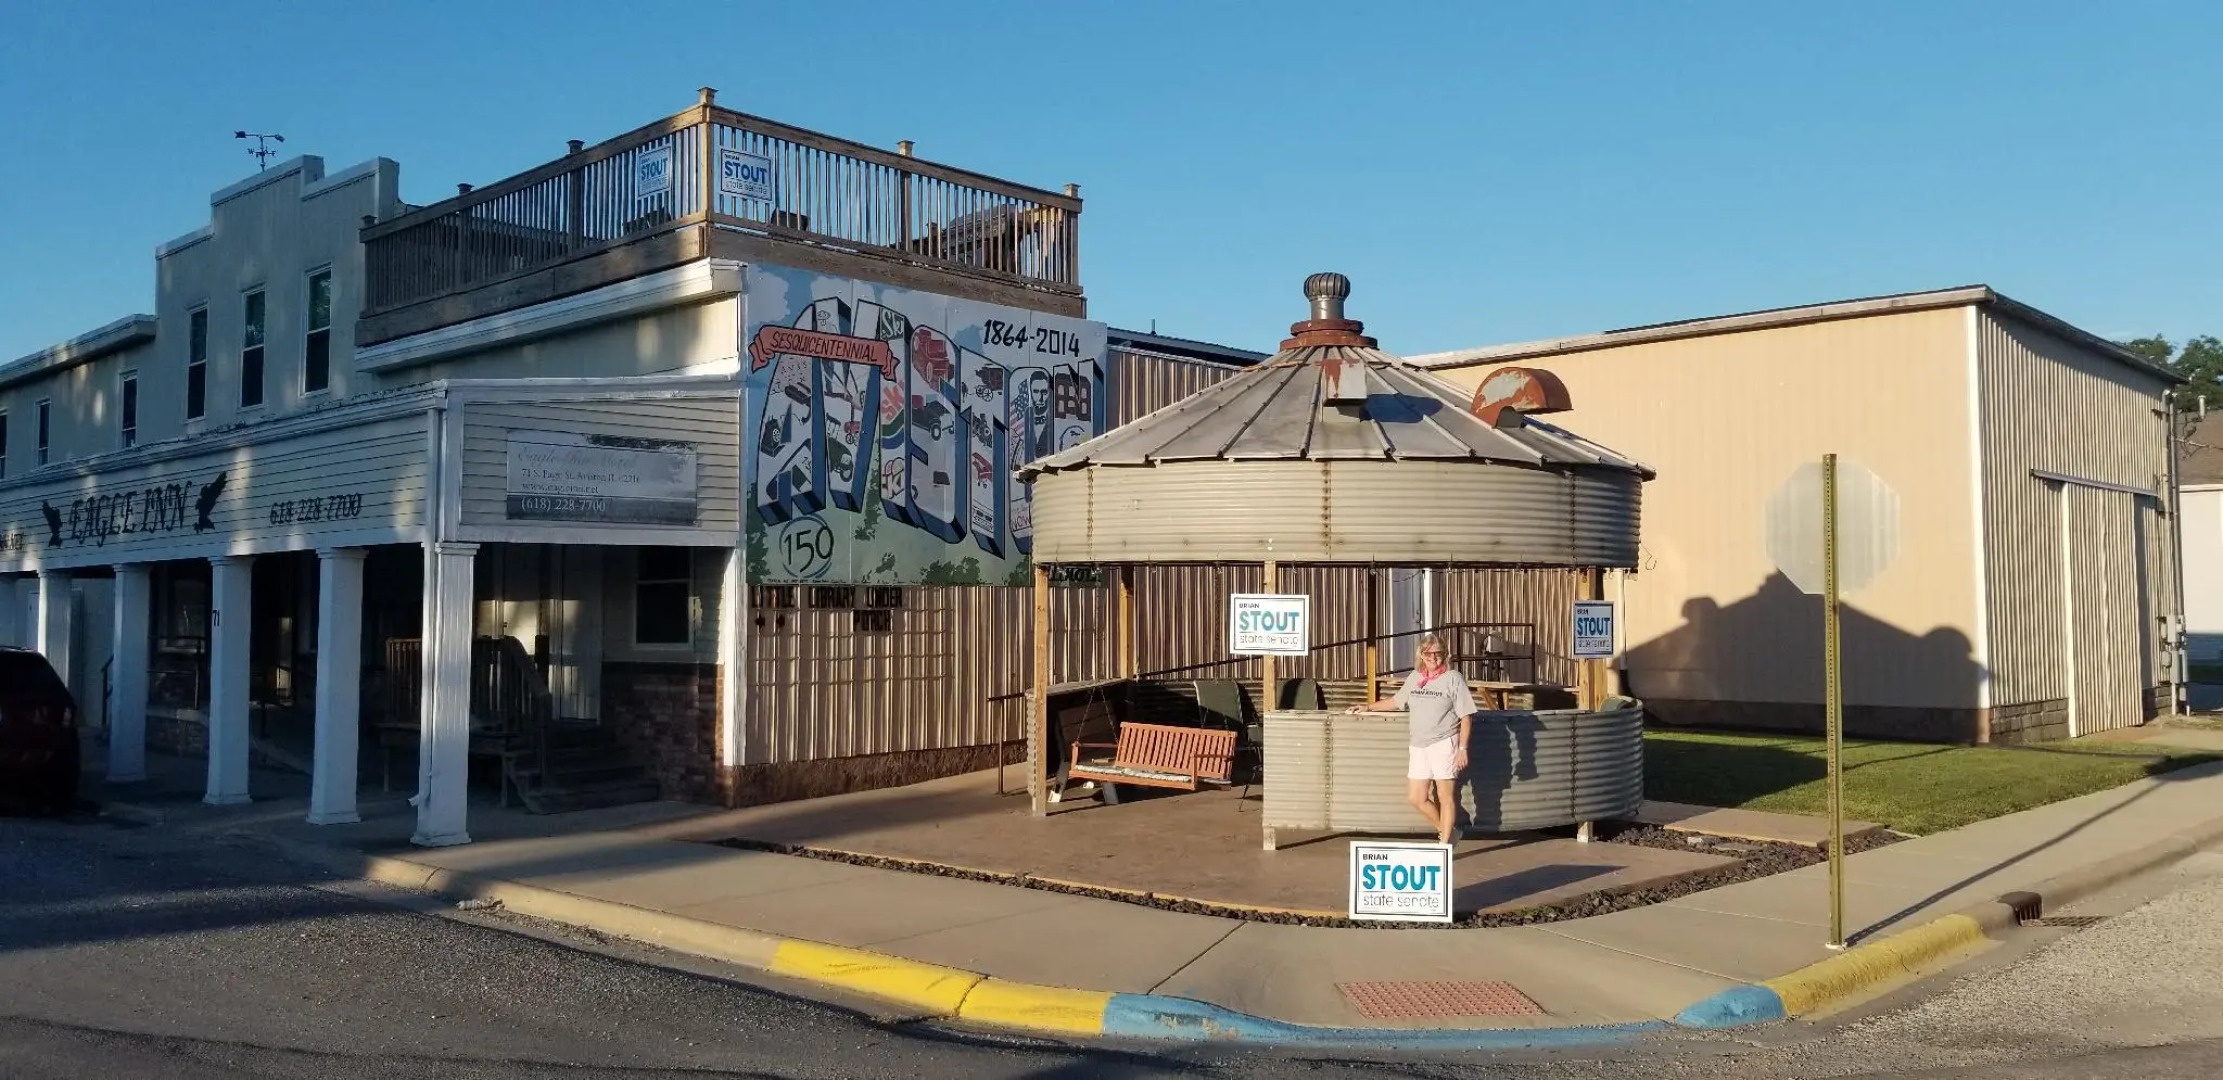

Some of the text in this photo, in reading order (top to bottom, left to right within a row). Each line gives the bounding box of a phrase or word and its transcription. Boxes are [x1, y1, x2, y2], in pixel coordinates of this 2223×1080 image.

[641, 157, 668, 181] STOUT
[724, 161, 768, 185] STOUT
[771, 331, 878, 362] SESQUICENTENNIAL
[983, 319, 1081, 358] 1864-2014
[69, 480, 192, 547] EAGLE INN
[270, 493, 362, 524] 618-228-7700
[521, 497, 606, 512] (618) 228-7700
[783, 526, 834, 574] 150
[212, 609, 220, 626] 71
[1239, 611, 1300, 631] STOUT
[1577, 617, 1610, 636] STOUT
[1362, 863, 1441, 891] STOUT
[1364, 894, 1439, 908] state senate
